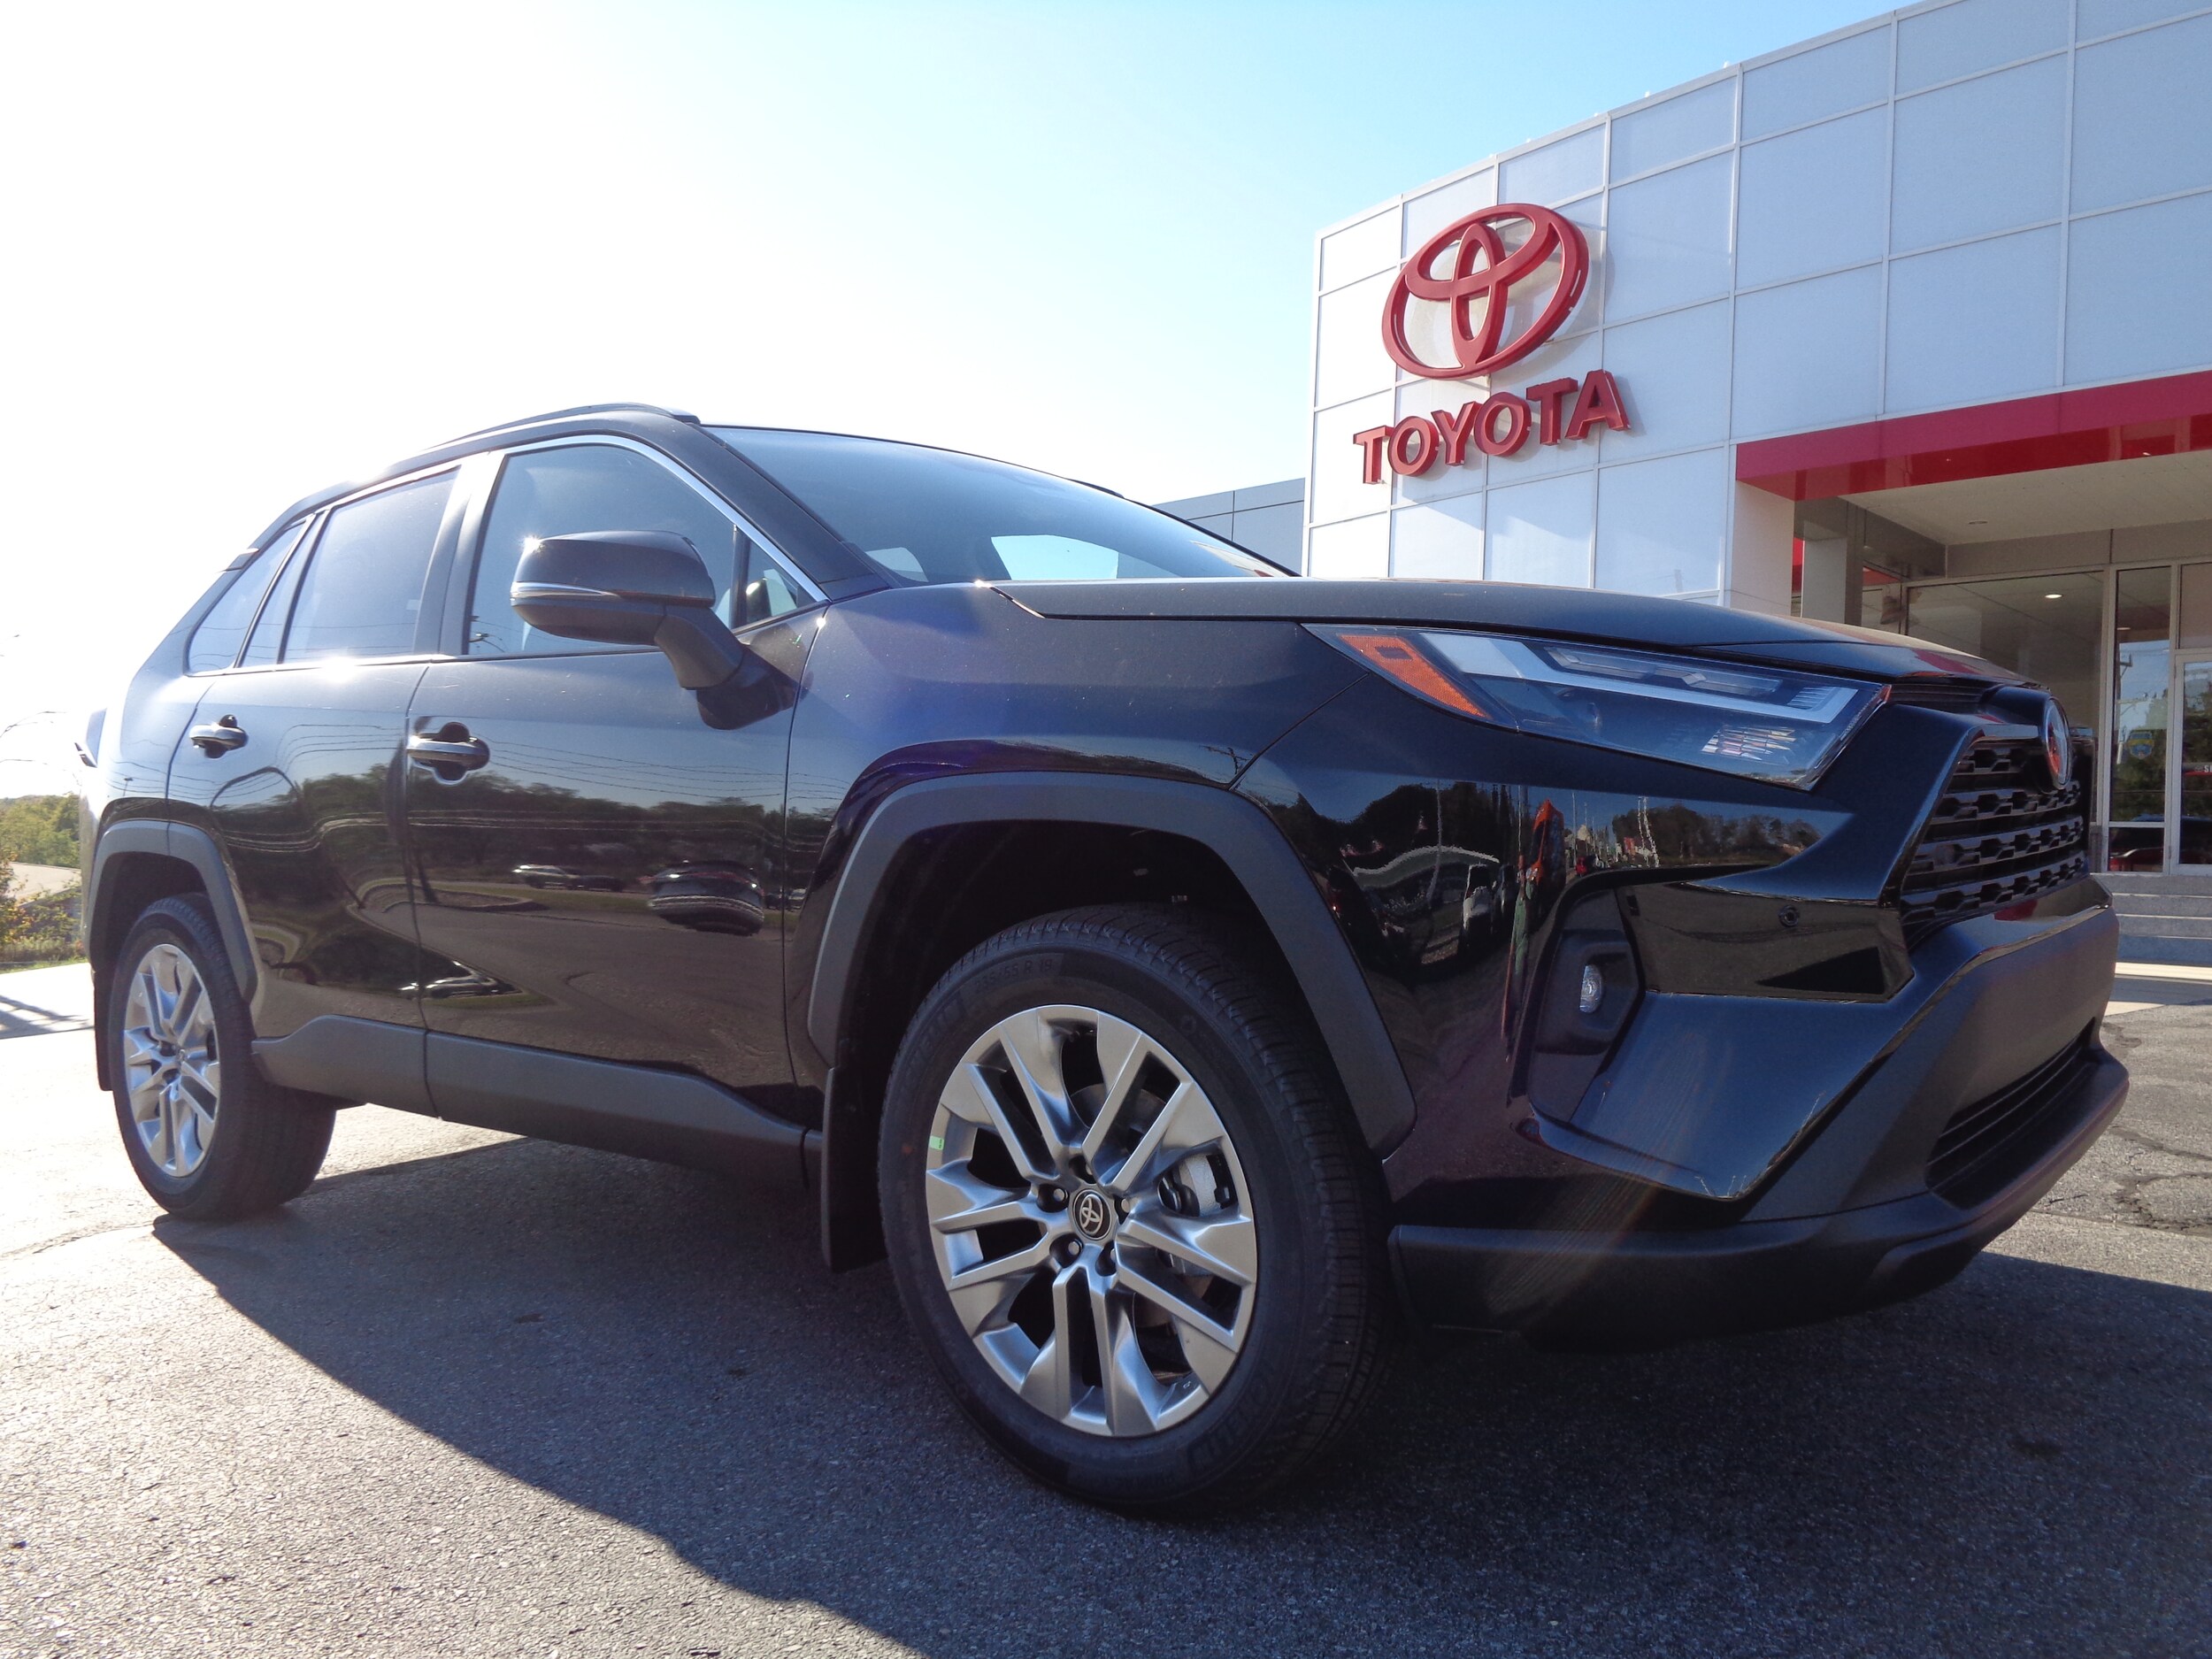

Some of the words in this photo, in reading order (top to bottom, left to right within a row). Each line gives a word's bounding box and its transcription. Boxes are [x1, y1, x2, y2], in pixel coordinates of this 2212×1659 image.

[1353, 369, 1630, 484] TOYOTA
[975, 963, 1019, 994] 235/55
[1024, 959, 1033, 974] R
[1040, 958, 1053, 972] 19
